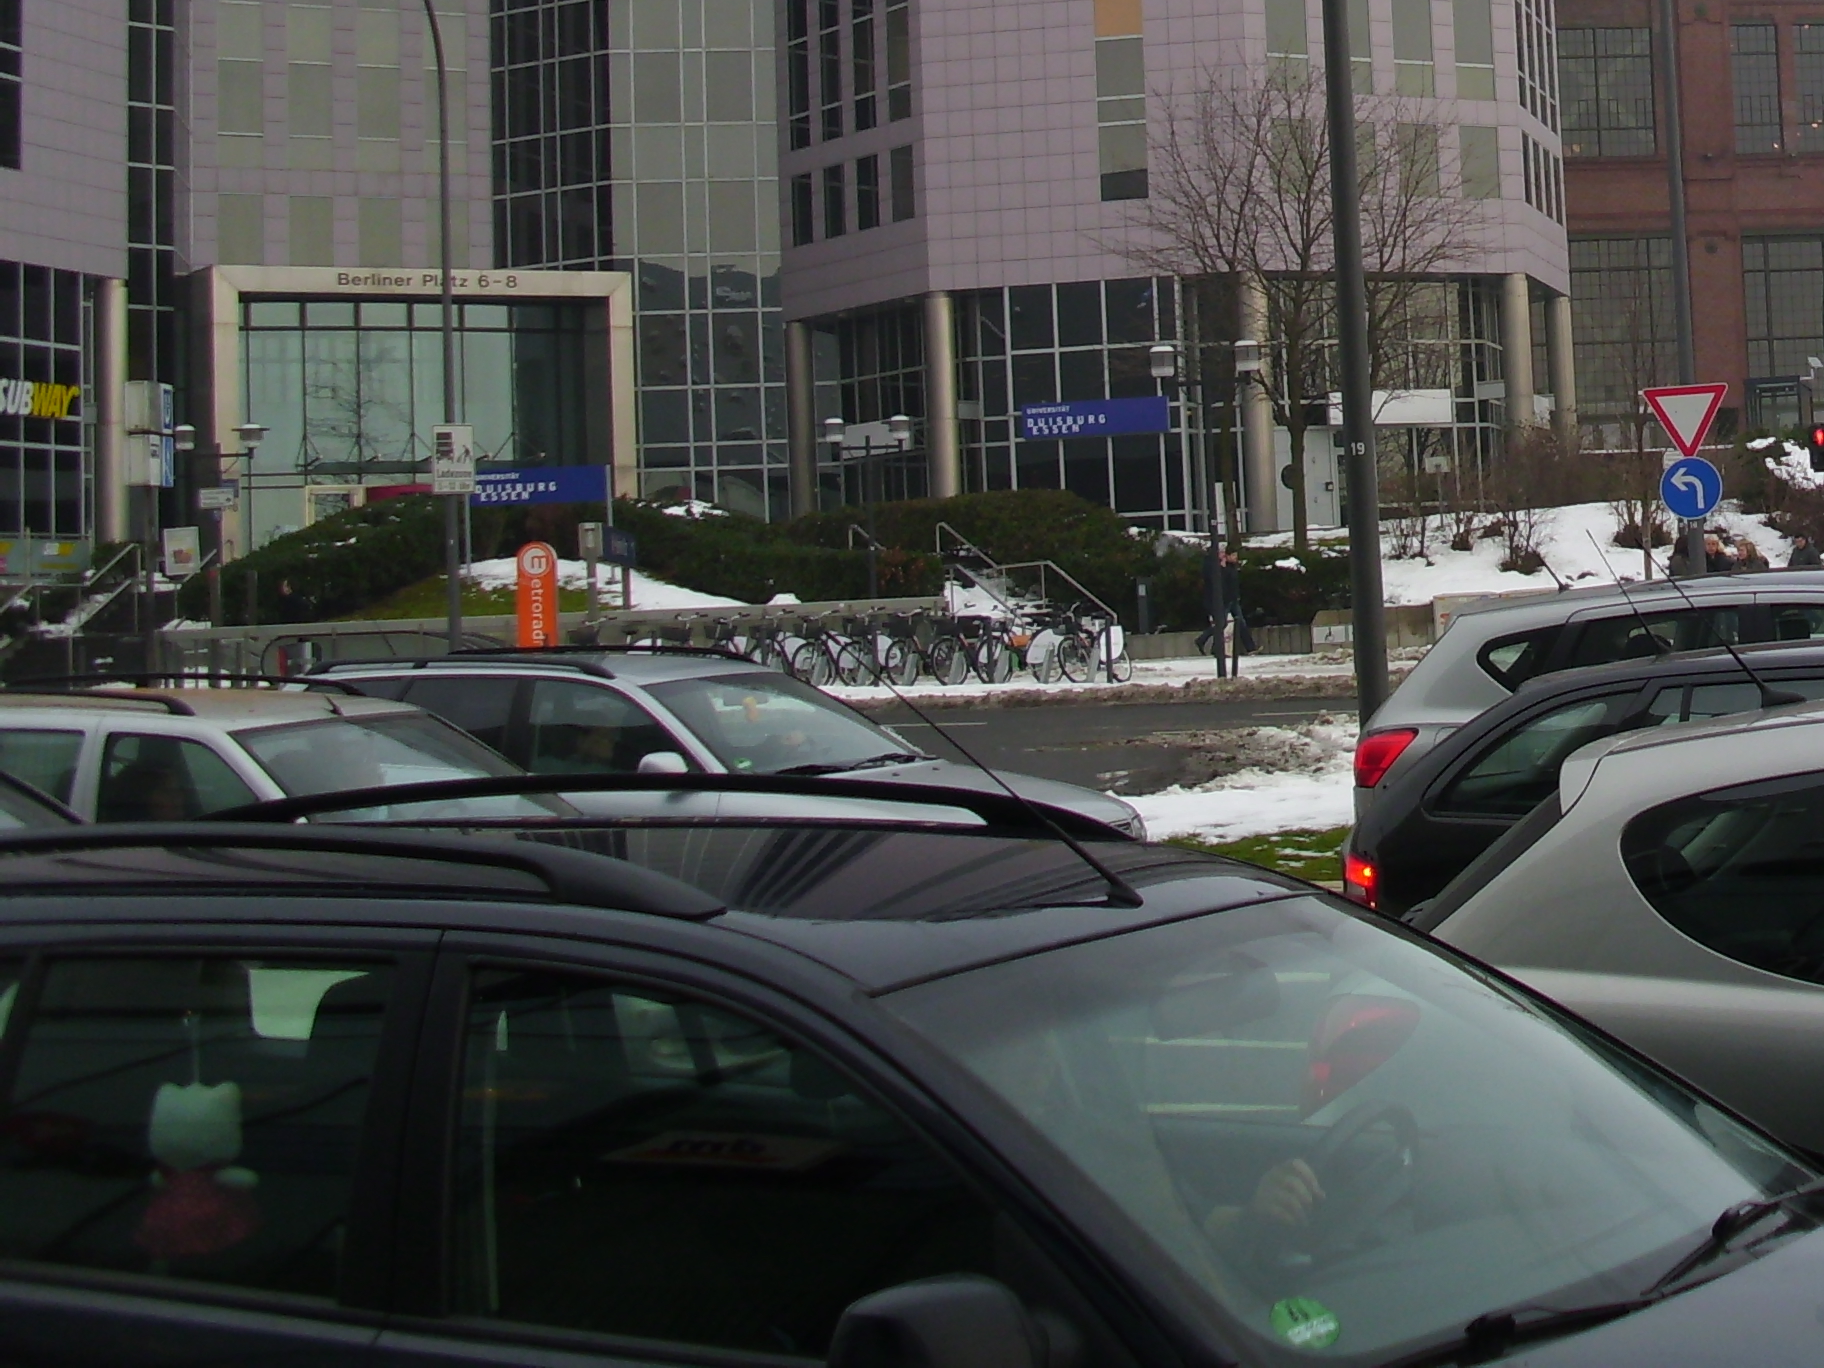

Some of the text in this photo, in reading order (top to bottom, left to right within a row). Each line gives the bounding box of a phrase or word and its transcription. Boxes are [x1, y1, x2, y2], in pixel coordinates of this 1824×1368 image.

[337, 272, 413, 287] Berliner
[422, 273, 468, 288] Pltz
[0, 377, 80, 418] SUBWAY
[1027, 414, 1106, 428] DUISBURG
[1032, 423, 1080, 435] ESSEN
[1350, 442, 1365, 456] 19
[475, 481, 557, 494] DUISBURG
[480, 490, 530, 502] ESSEN
